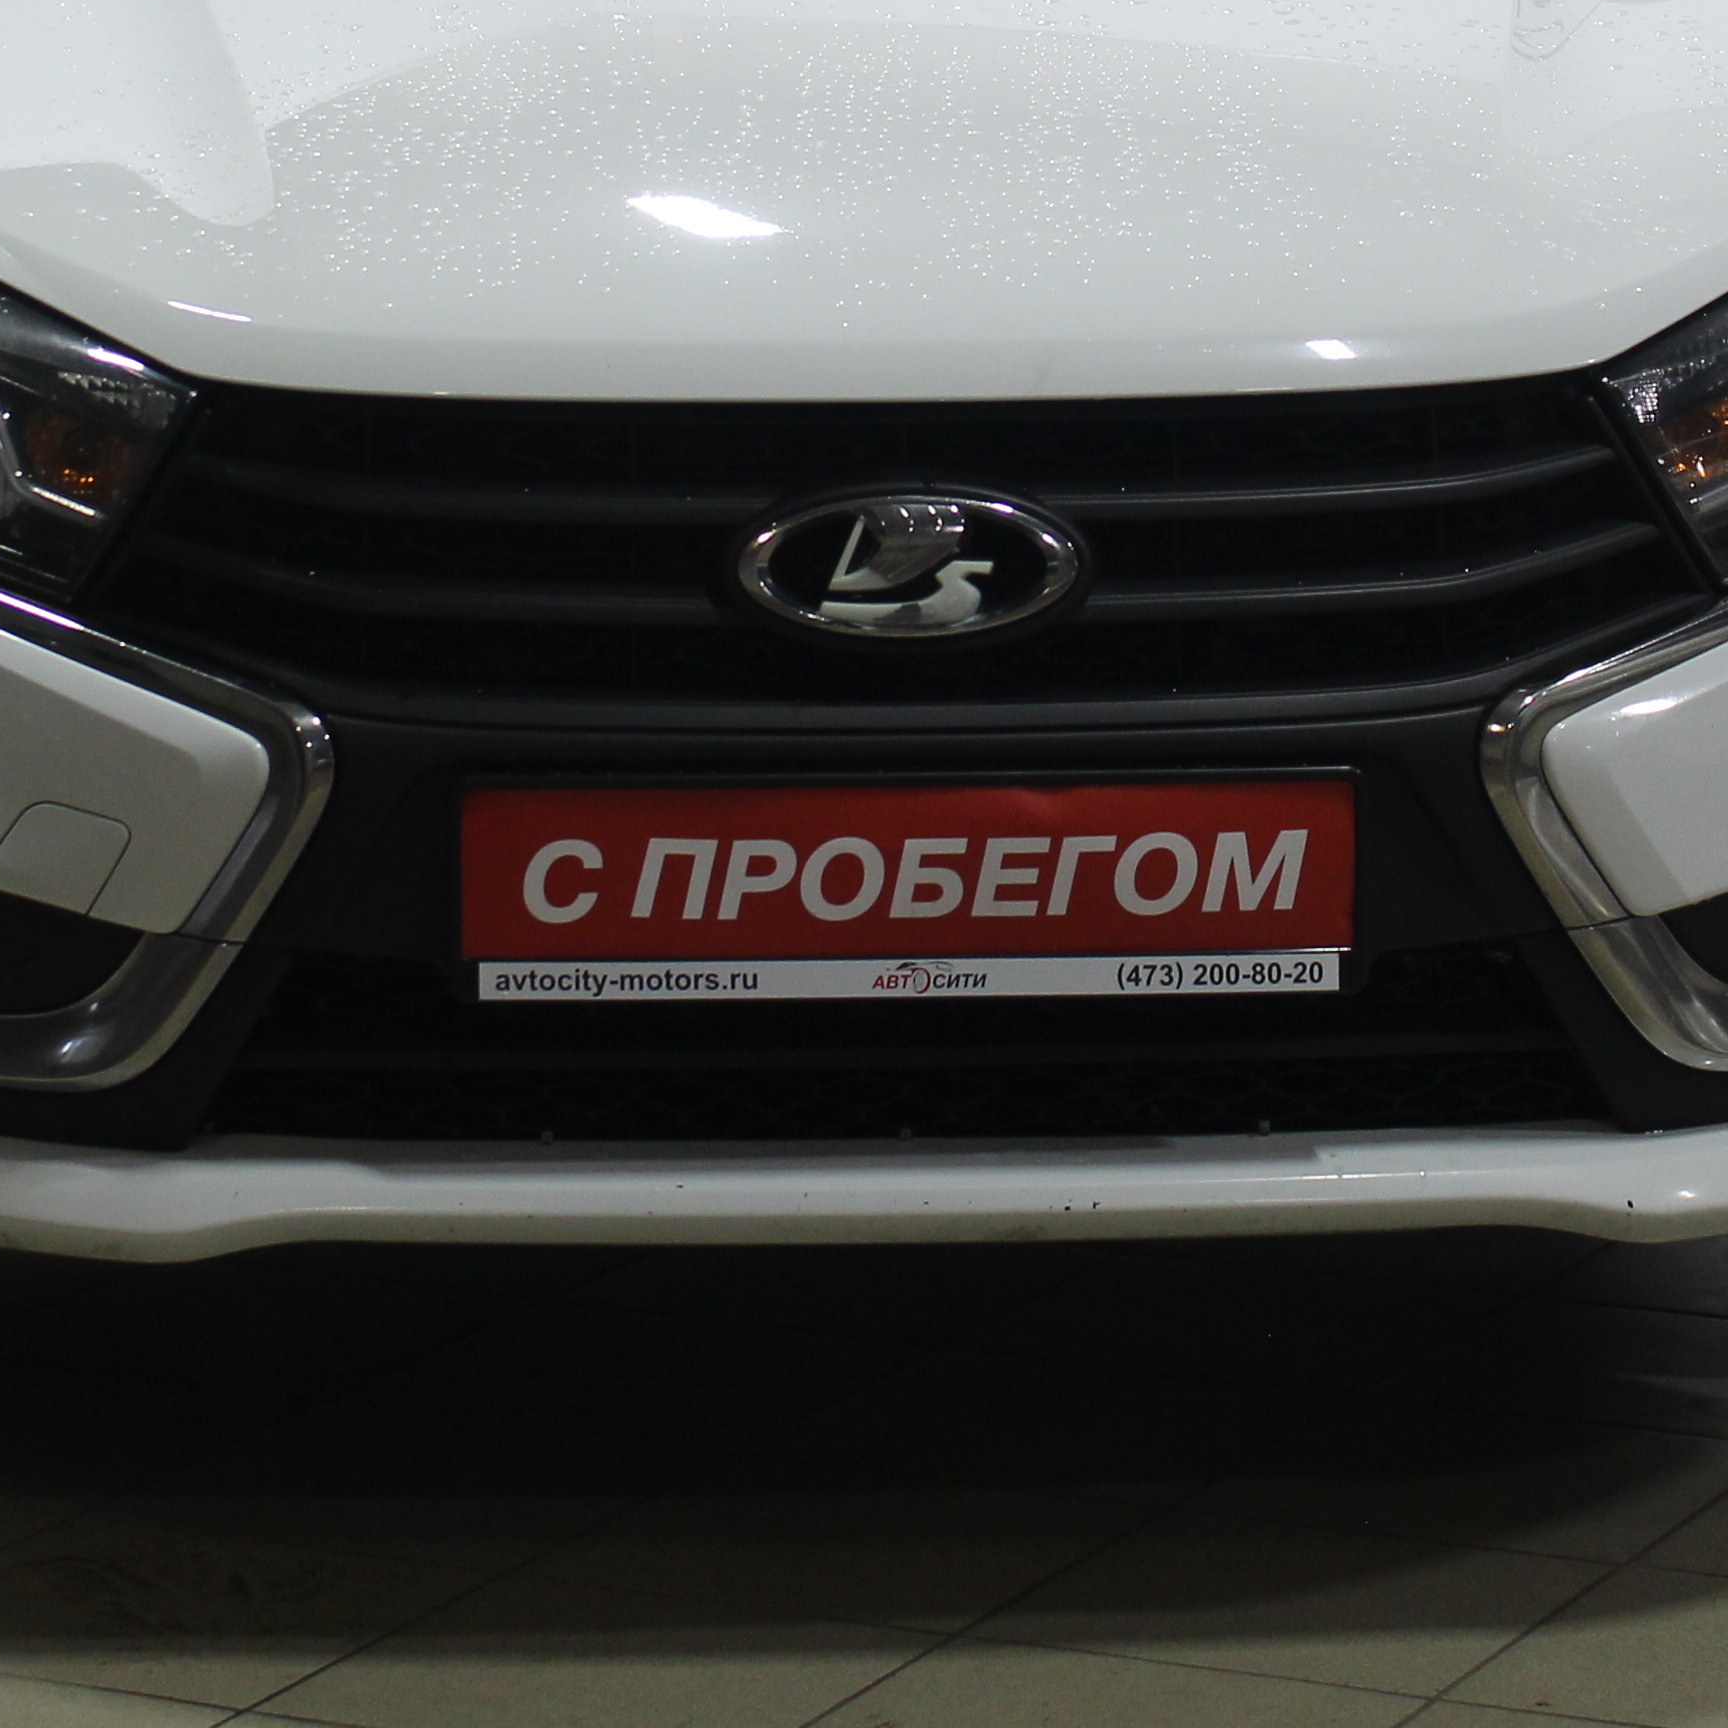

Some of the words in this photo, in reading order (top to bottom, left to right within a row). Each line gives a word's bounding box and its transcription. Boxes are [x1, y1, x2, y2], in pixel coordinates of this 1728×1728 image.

[523, 839, 604, 924] С
[630, 828, 1309, 922] ПРОБЕГОМ
[495, 969, 758, 996] avtocity-motors.ru
[1117, 961, 1184, 991] (473)
[1193, 961, 1324, 986] 200-80-20
